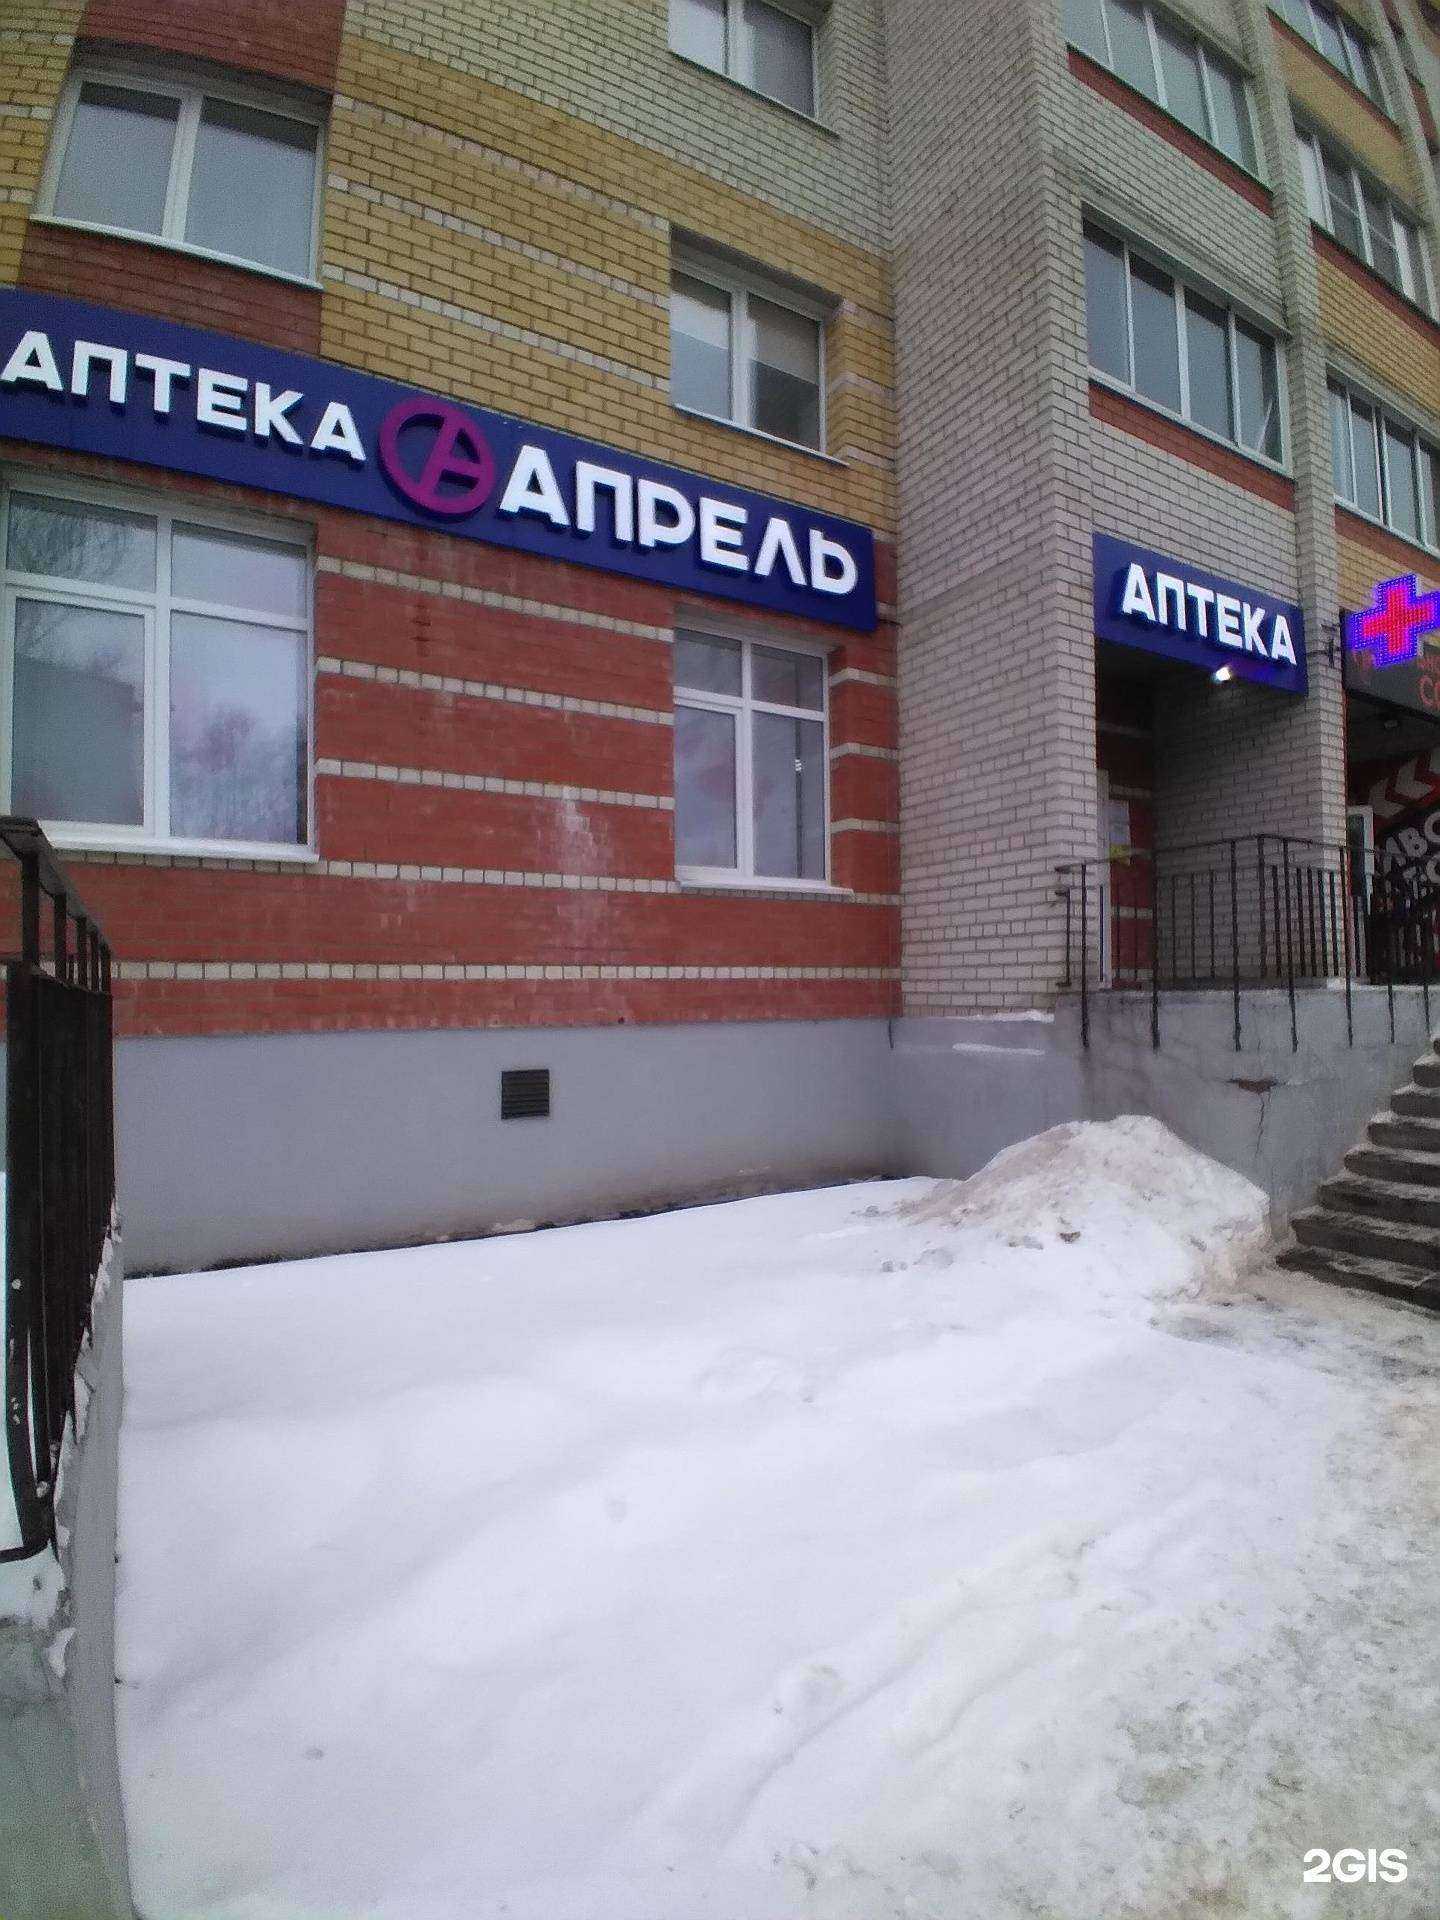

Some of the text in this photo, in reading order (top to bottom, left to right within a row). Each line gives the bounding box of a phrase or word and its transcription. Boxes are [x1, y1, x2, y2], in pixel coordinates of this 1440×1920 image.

[1, 330, 859, 596] АПТЕКА АПРЕЛЬ
[1121, 562, 1298, 665] АПТЕКА
